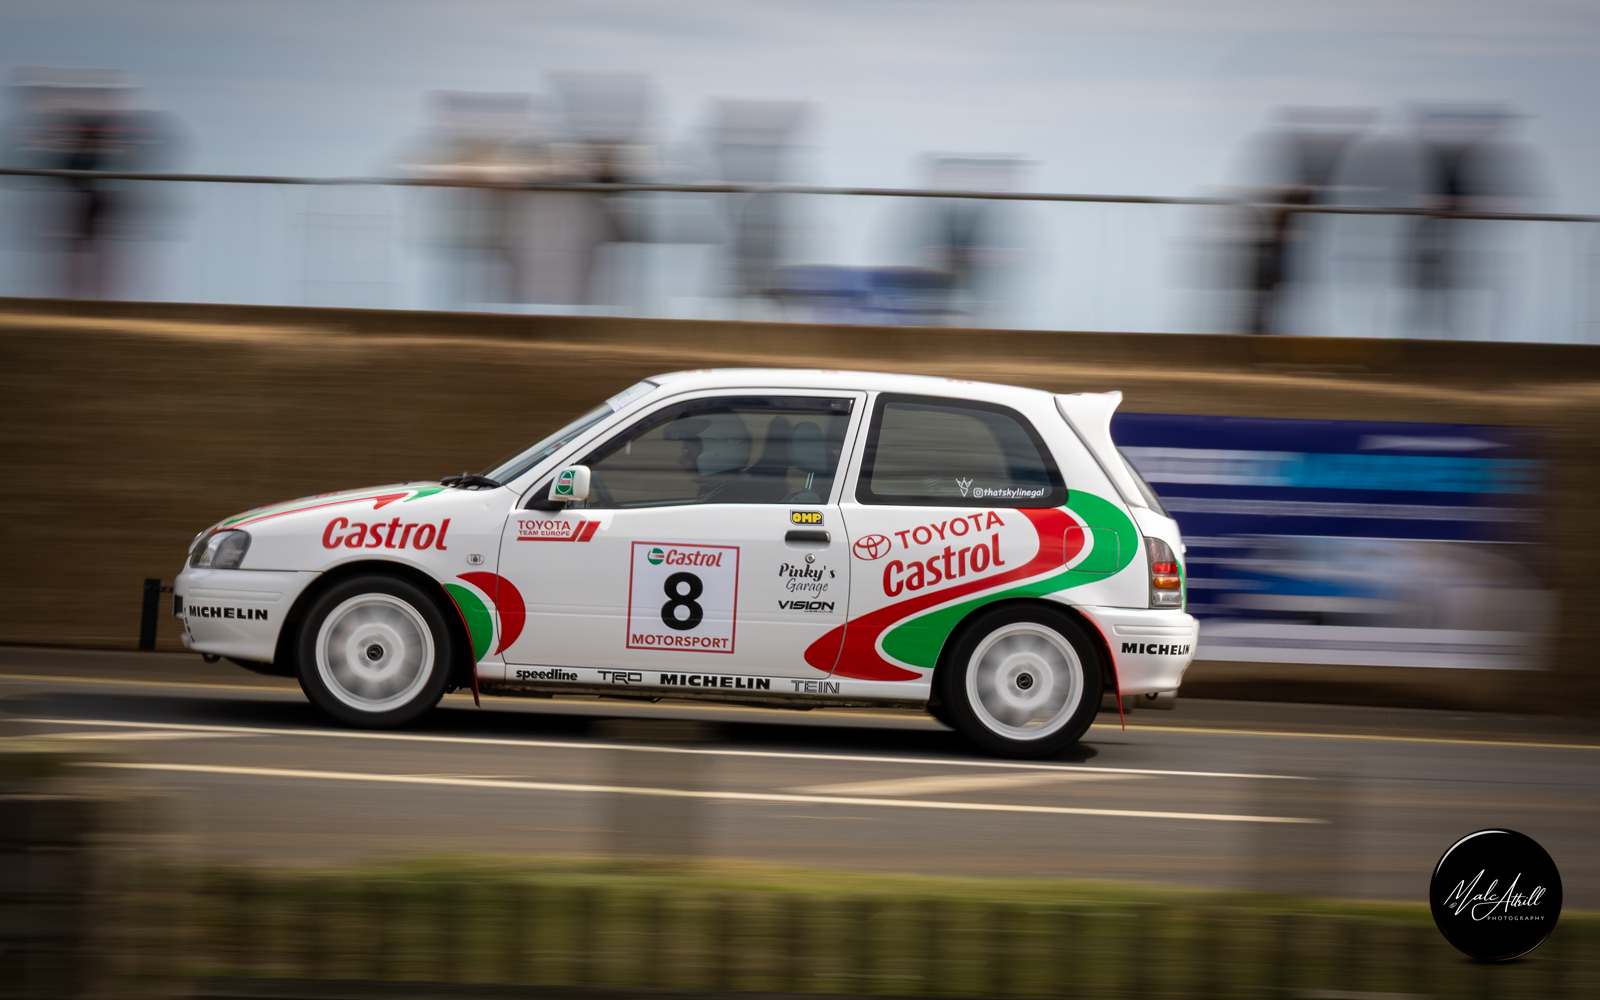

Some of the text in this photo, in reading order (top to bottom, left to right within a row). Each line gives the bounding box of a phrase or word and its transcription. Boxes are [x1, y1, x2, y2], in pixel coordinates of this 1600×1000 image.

[984, 487, 1045, 498] thatskylinegal
[792, 512, 822, 523] OMP
[517, 520, 571, 530] TOYOTA
[895, 511, 1005, 549] TOYOTA
[322, 517, 450, 550] Castrol
[665, 549, 722, 567] Castrol
[882, 533, 1005, 597] Castrol
[779, 563, 836, 582] Pinky's
[786, 578, 828, 599] Garage
[661, 571, 703, 631] 8
[778, 600, 835, 610] VISION
[189, 605, 268, 620] MICHELIN
[632, 634, 729, 648] MOTORSPORT
[1122, 642, 1190, 655] MICHELIN
[516, 669, 578, 681] speedline
[598, 671, 642, 684] TRD
[660, 674, 770, 690] MICHELIN
[791, 680, 840, 694] TEIN
